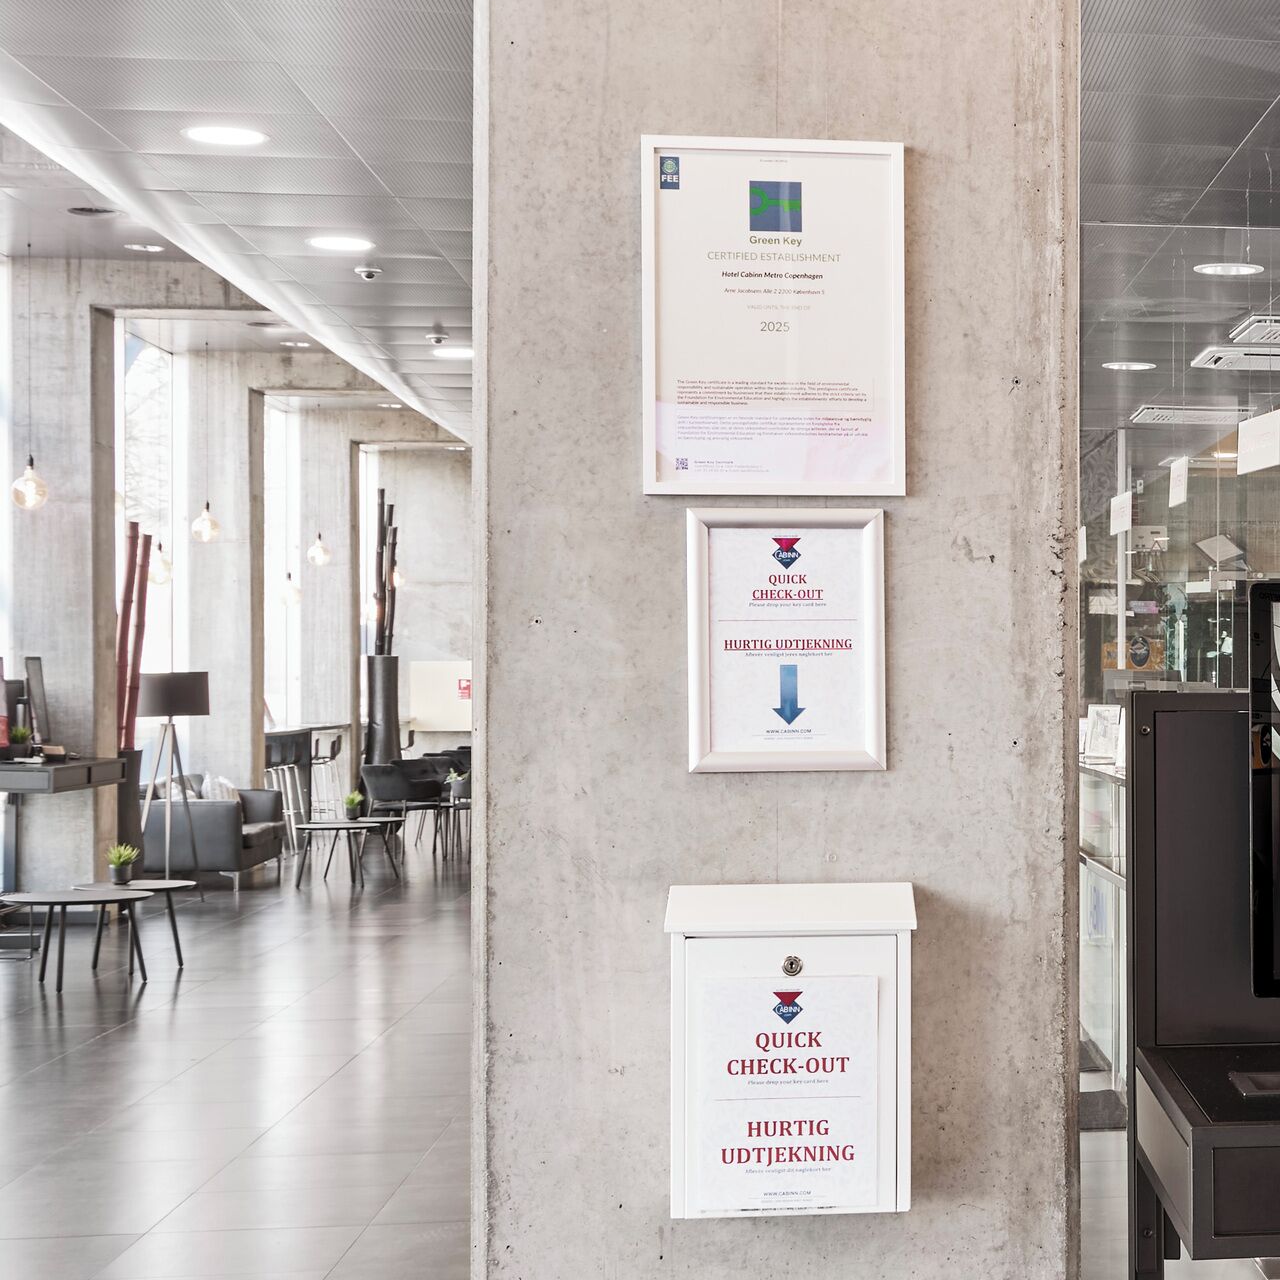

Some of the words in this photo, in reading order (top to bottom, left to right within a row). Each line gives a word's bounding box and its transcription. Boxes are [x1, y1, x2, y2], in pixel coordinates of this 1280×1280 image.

[661, 174, 679, 183] FEE
[749, 235, 780, 245] Green
[783, 236, 802, 247] Key
[707, 251, 758, 261] CERTIFIED
[760, 252, 841, 262] ESTABLISHMENT
[784, 272, 823, 280] Copenhagen
[760, 321, 790, 332] 2025
[775, 550, 799, 560] CABINN
[769, 574, 807, 586] QUICK
[752, 589, 824, 600] CHECK-OUT
[724, 639, 772, 650] HURTIG
[776, 638, 852, 650] UDTJEKNING
[775, 1004, 800, 1014] CABINN
[755, 1031, 822, 1052] QUICK
[727, 1056, 850, 1076] CHECK-OUT
[747, 1119, 830, 1138] HURTIG
[721, 1144, 855, 1167] UDTJEKNING
